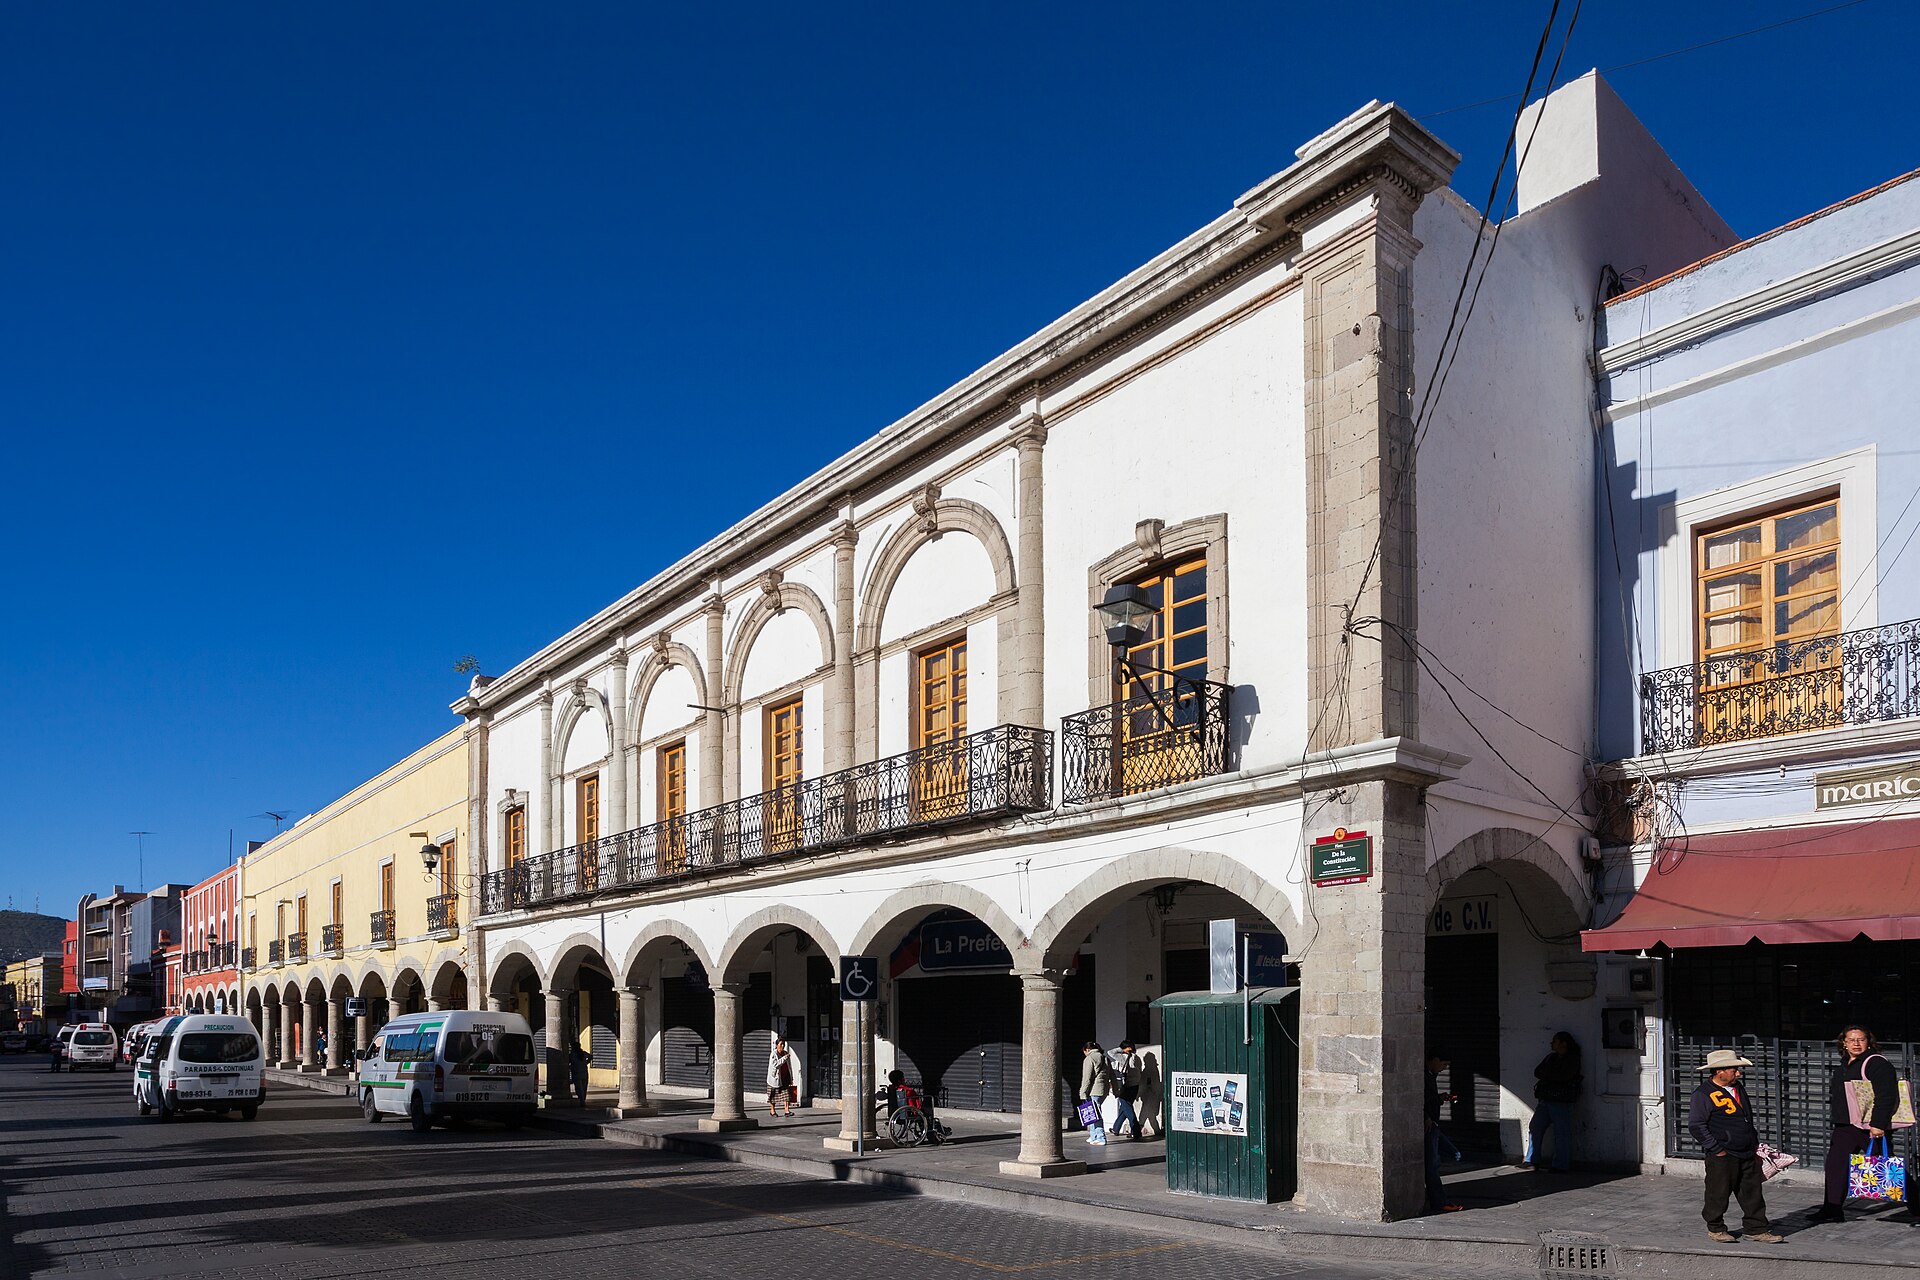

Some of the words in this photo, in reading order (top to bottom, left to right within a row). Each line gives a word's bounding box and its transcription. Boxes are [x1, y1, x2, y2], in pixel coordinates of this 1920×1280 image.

[1323, 856, 1356, 865] Constitución
[1434, 904, 1453, 932] de
[1462, 902, 1492, 931] C.V.
[934, 937, 952, 955] La
[481, 1032, 494, 1041] 05
[495, 1065, 527, 1073] CONTINUAS
[1175, 1077, 1185, 1085] LOS
[1185, 1077, 1208, 1087] MEJORES
[455, 1092, 469, 1101] 019
[470, 1092, 484, 1101] 512
[1175, 1086, 1208, 1098] EQUIPOS
[1177, 1100, 1194, 1108] ADEMÁS
